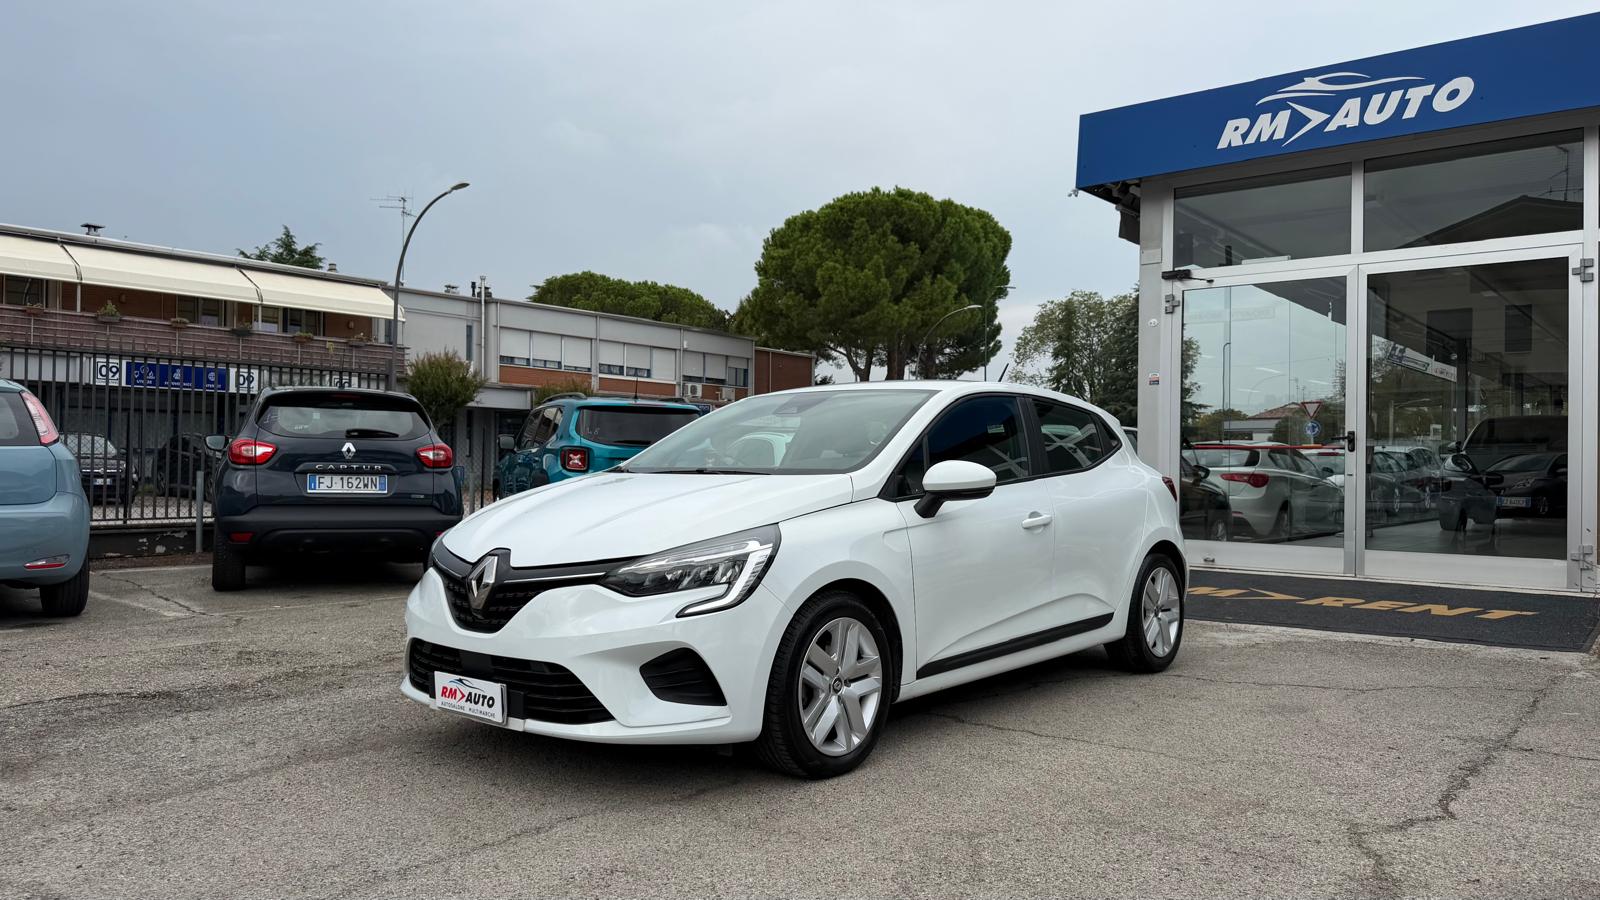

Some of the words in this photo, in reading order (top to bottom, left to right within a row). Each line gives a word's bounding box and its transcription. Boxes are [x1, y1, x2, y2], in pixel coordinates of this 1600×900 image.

[1216, 109, 1292, 149] RM
[1324, 76, 1475, 133] AUTO
[340, 476, 378, 490] 162WN
[1296, 596, 1541, 620] RENT
[440, 686, 458, 700] RM
[465, 691, 495, 709] AUTO
[441, 701, 466, 711] AUTOSALONE
[468, 707, 496, 719] MULTIMARCHE
